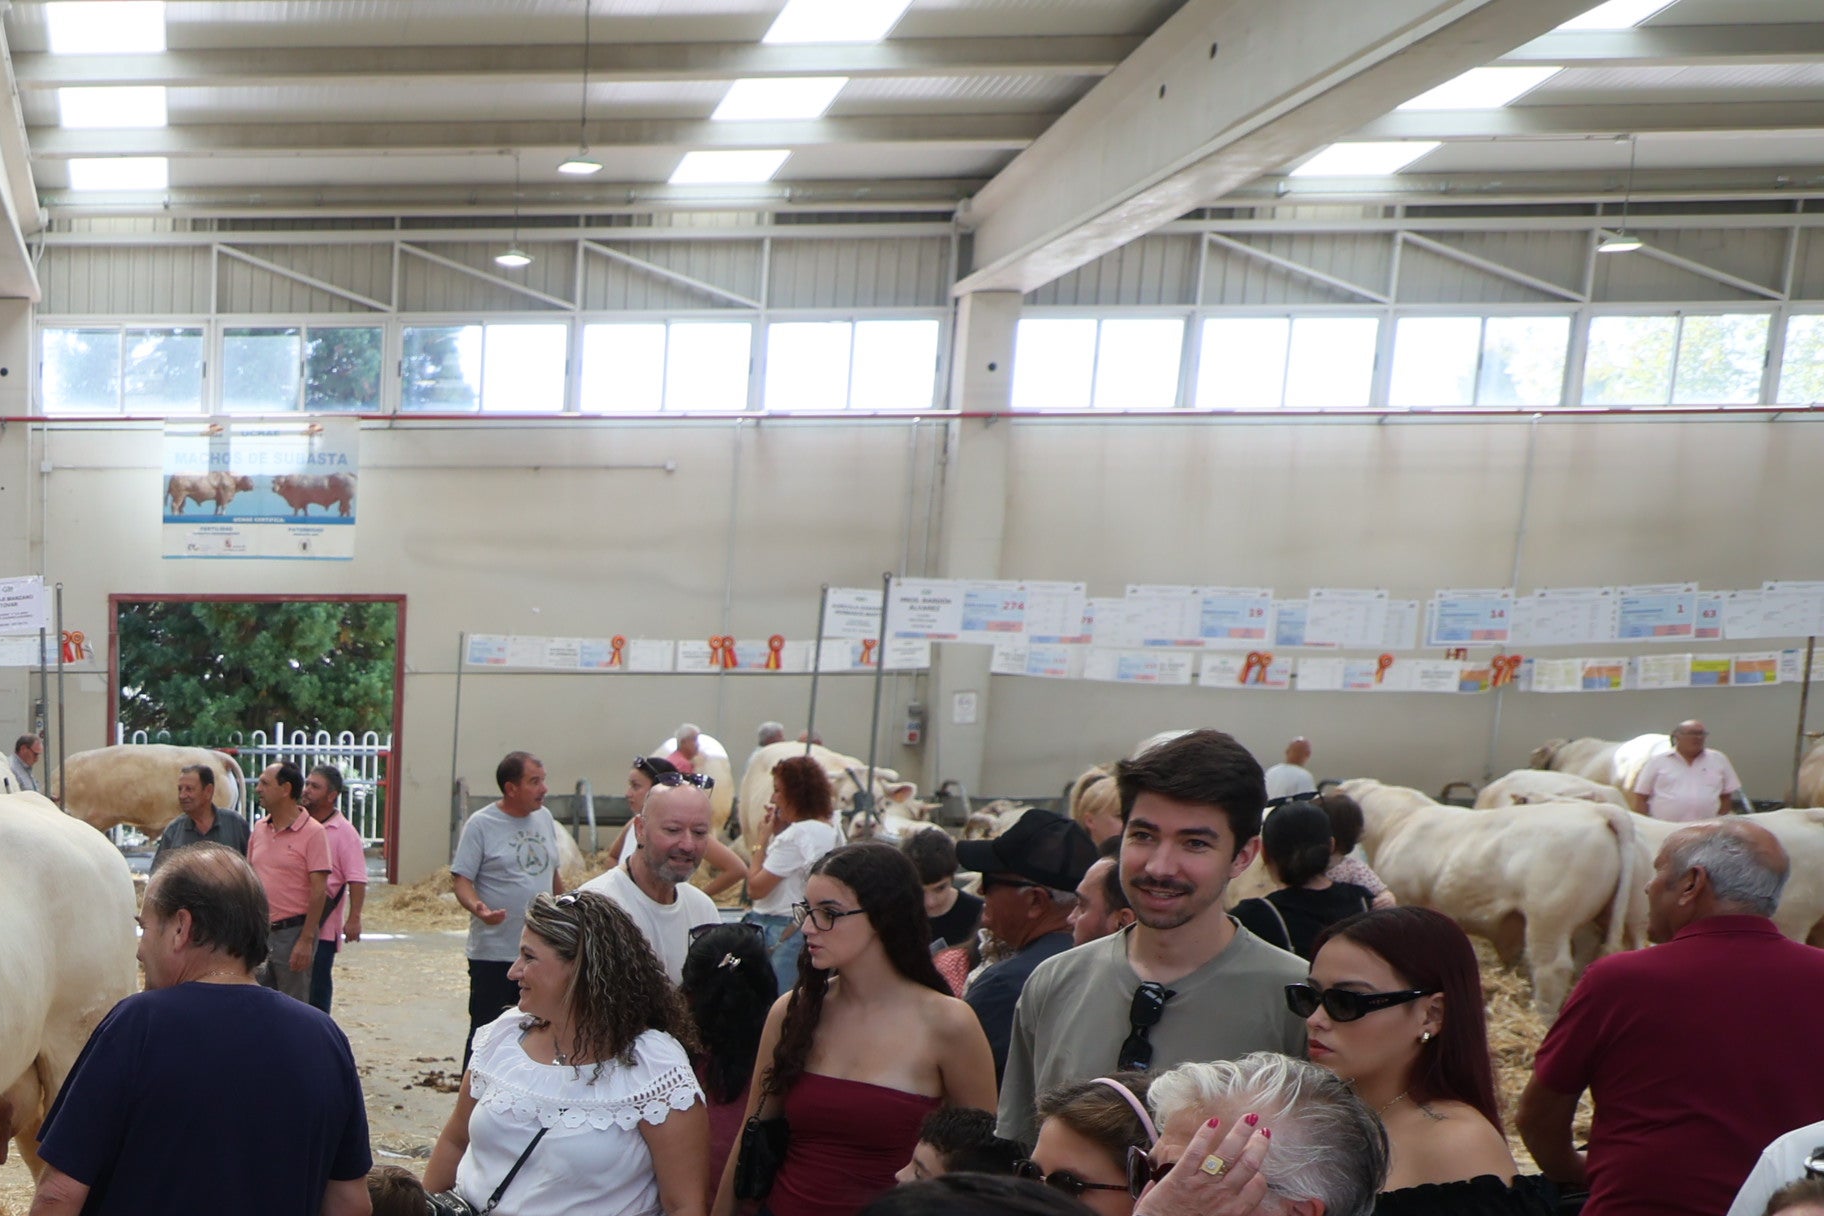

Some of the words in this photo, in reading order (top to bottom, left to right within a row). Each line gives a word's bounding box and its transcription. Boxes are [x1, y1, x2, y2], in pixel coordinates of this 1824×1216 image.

[176, 452, 243, 465] MACHOS
[248, 452, 270, 465] DE
[273, 452, 348, 466] SUBASTA
